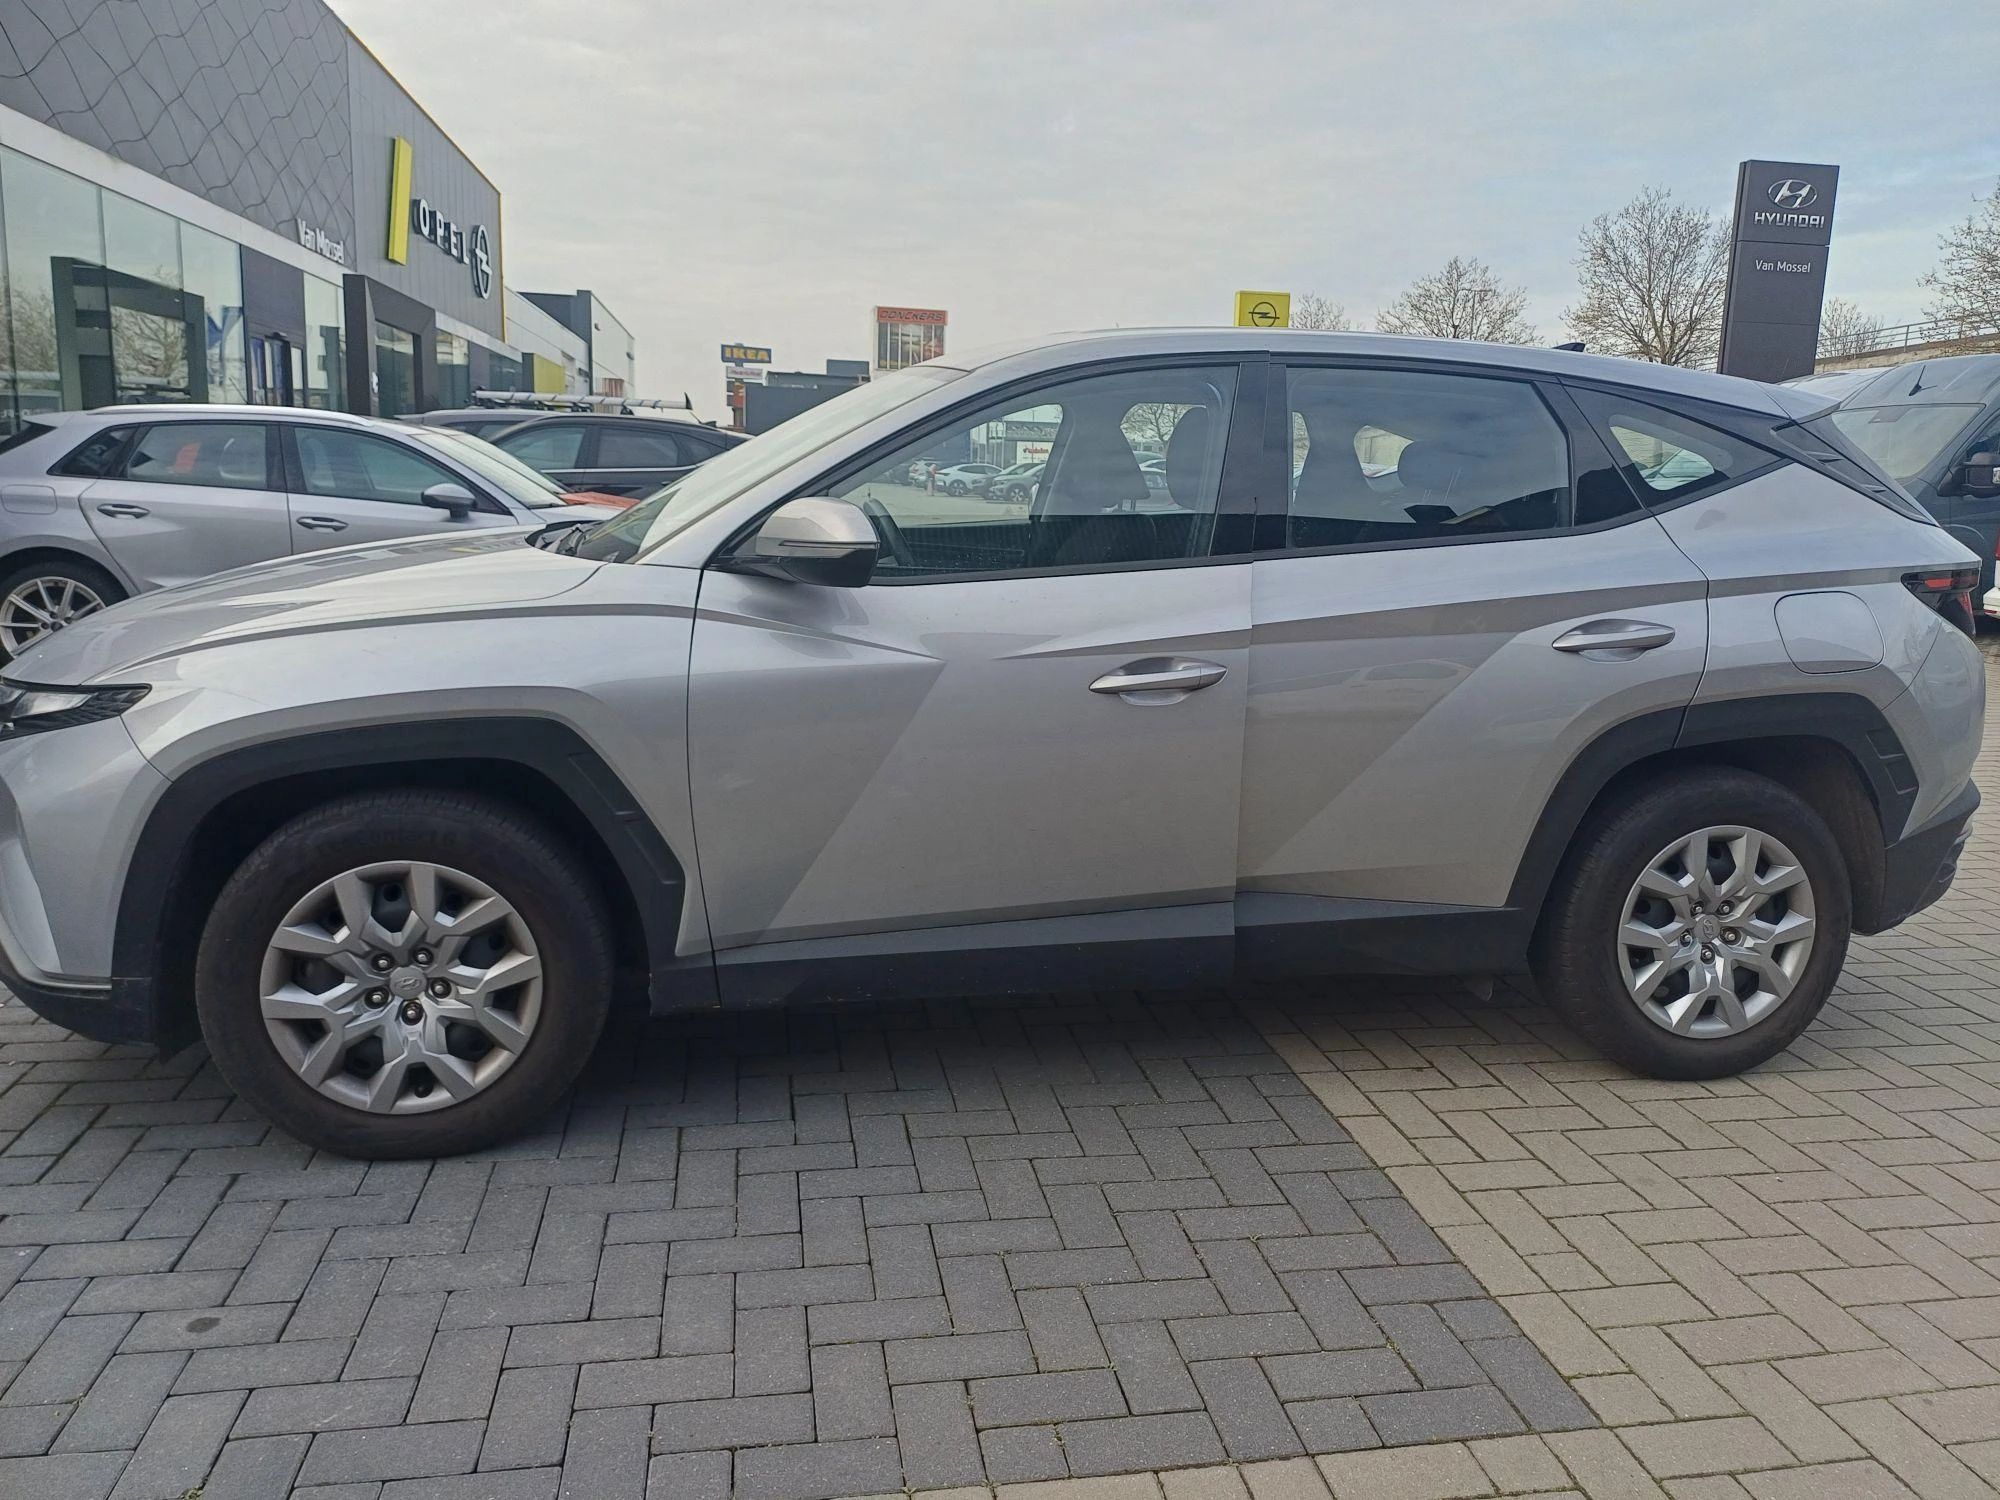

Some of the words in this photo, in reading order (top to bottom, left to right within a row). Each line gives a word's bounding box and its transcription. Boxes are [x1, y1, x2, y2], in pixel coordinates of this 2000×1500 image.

[1754, 212, 1825, 228] HYUNDAI
[417, 198, 470, 265] OPEL
[297, 217, 316, 249] Van
[316, 227, 345, 264] Mossel
[1755, 259, 1774, 271] Van
[1776, 261, 1811, 272] Mossel
[724, 346, 769, 360] IKEA
